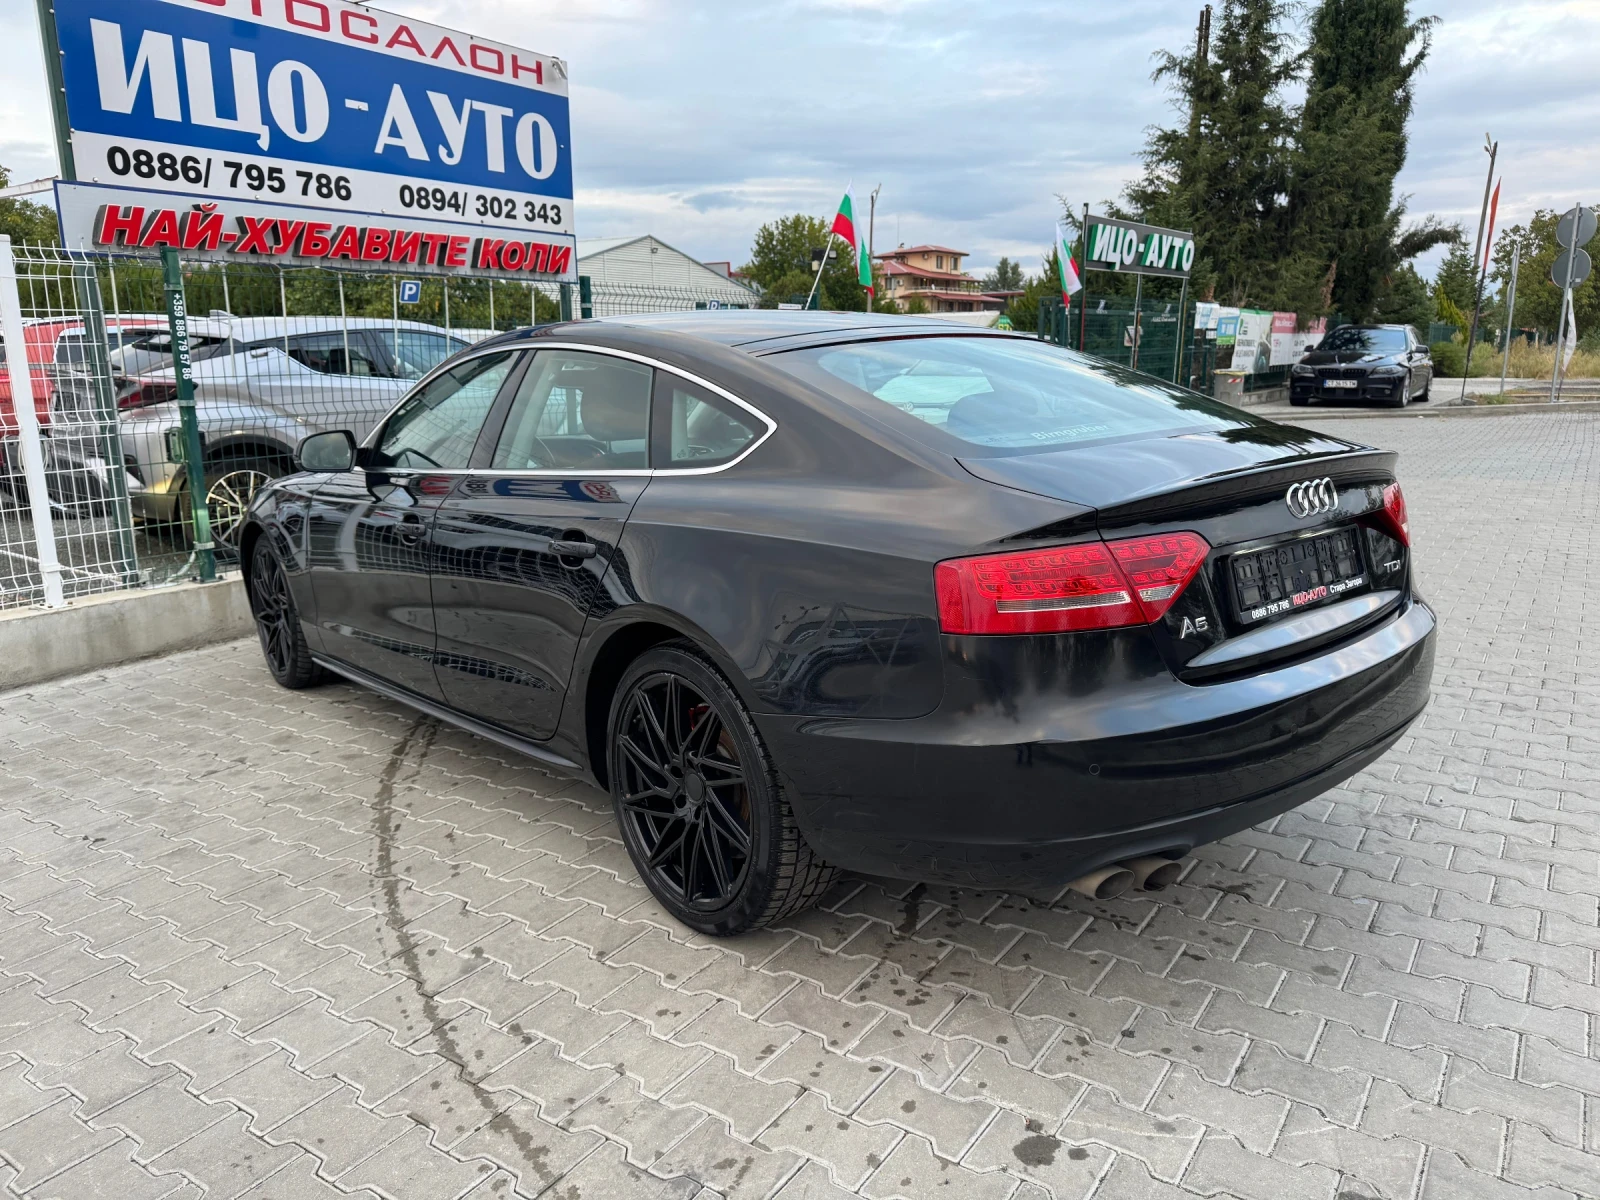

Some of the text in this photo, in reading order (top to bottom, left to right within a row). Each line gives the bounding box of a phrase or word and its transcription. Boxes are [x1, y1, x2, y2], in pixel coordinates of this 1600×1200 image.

[195, 0, 544, 84] ОСАЛОН
[107, 146, 562, 225] 0886/ 795 786 0894/ 302 343
[98, 202, 572, 274] НАЙ-ХУБАВИТЕ КОЛИ
[1092, 223, 1195, 271] ИЦО-АУТО
[173, 293, 192, 380] +359 886 79 57 86
[1030, 424, 1109, 440] Birngruber
[1383, 559, 1401, 573] TDI
[1267, 603, 1279, 614] 795
[1329, 582, 1346, 593] Стара
[1346, 577, 1363, 587] Загора
[1179, 616, 1208, 639] A5
